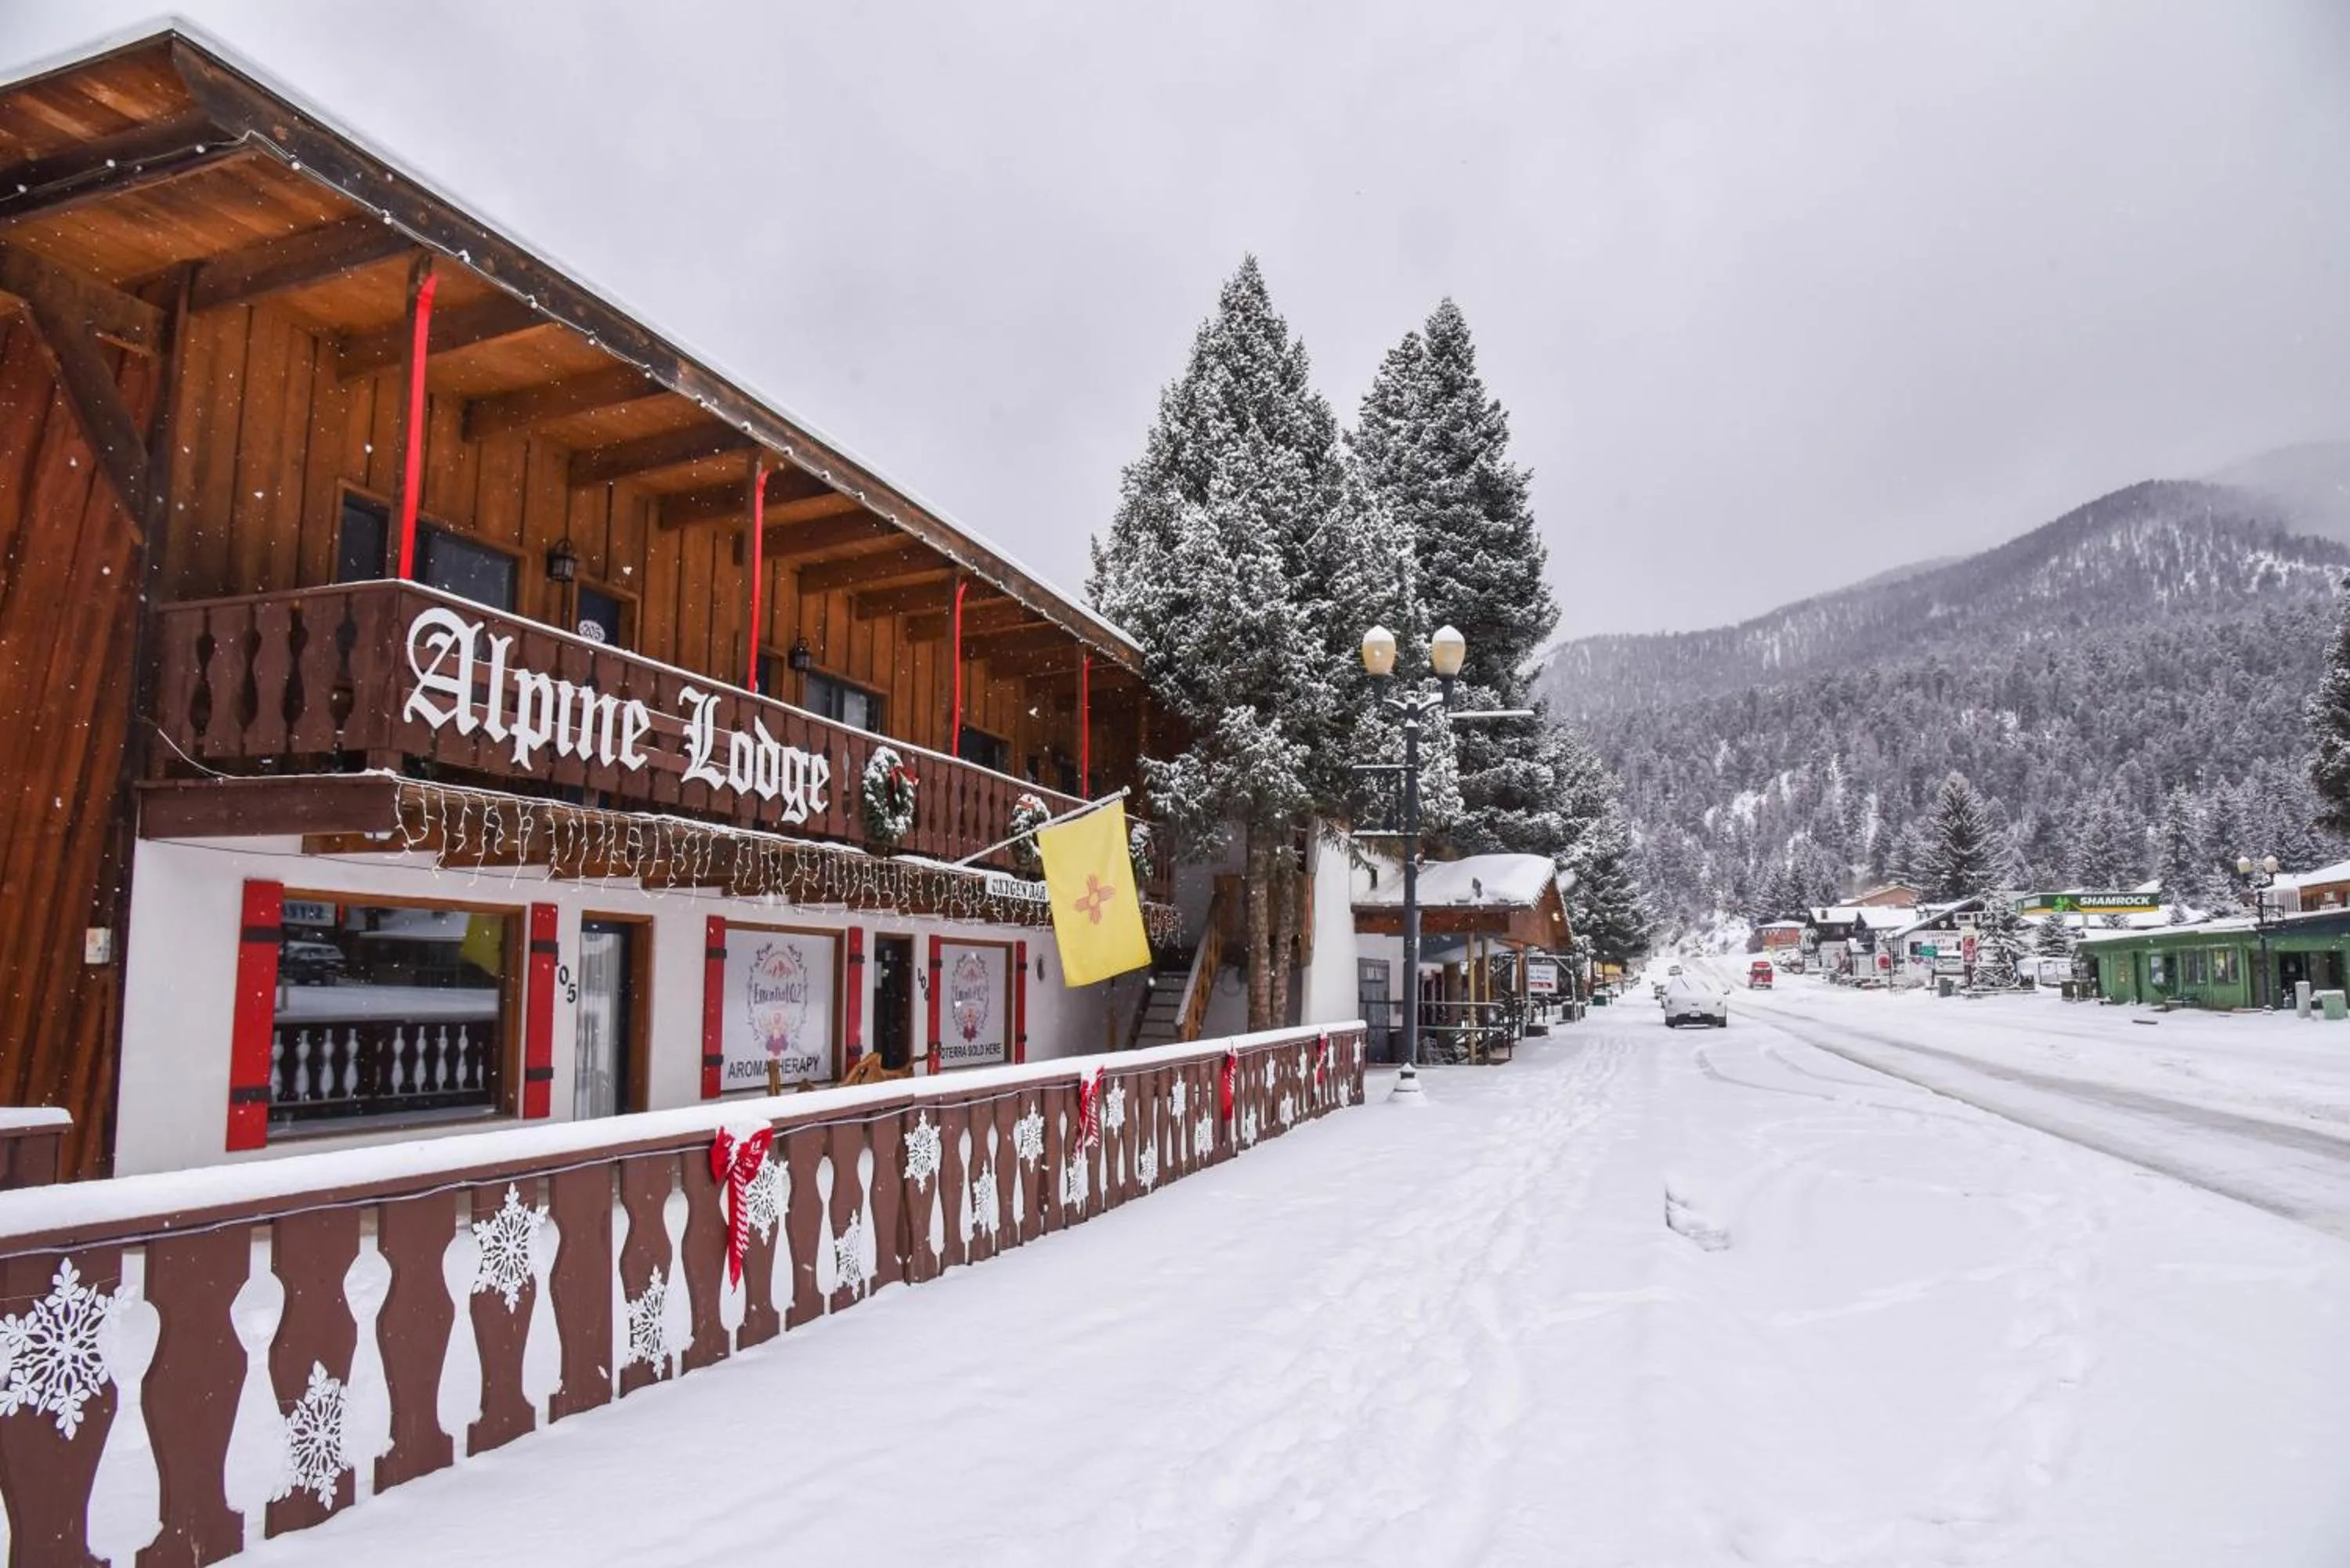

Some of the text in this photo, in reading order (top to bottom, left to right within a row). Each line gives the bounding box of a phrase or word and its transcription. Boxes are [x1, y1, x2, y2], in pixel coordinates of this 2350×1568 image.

[403, 606, 831, 825] Alpine Lodge
[2080, 896, 2150, 905] SHAMROCK
[968, 1044, 984, 1057] SOLD
[985, 1042, 1002, 1054] HERE
[728, 1056, 820, 1078] AROMAHERAPY
